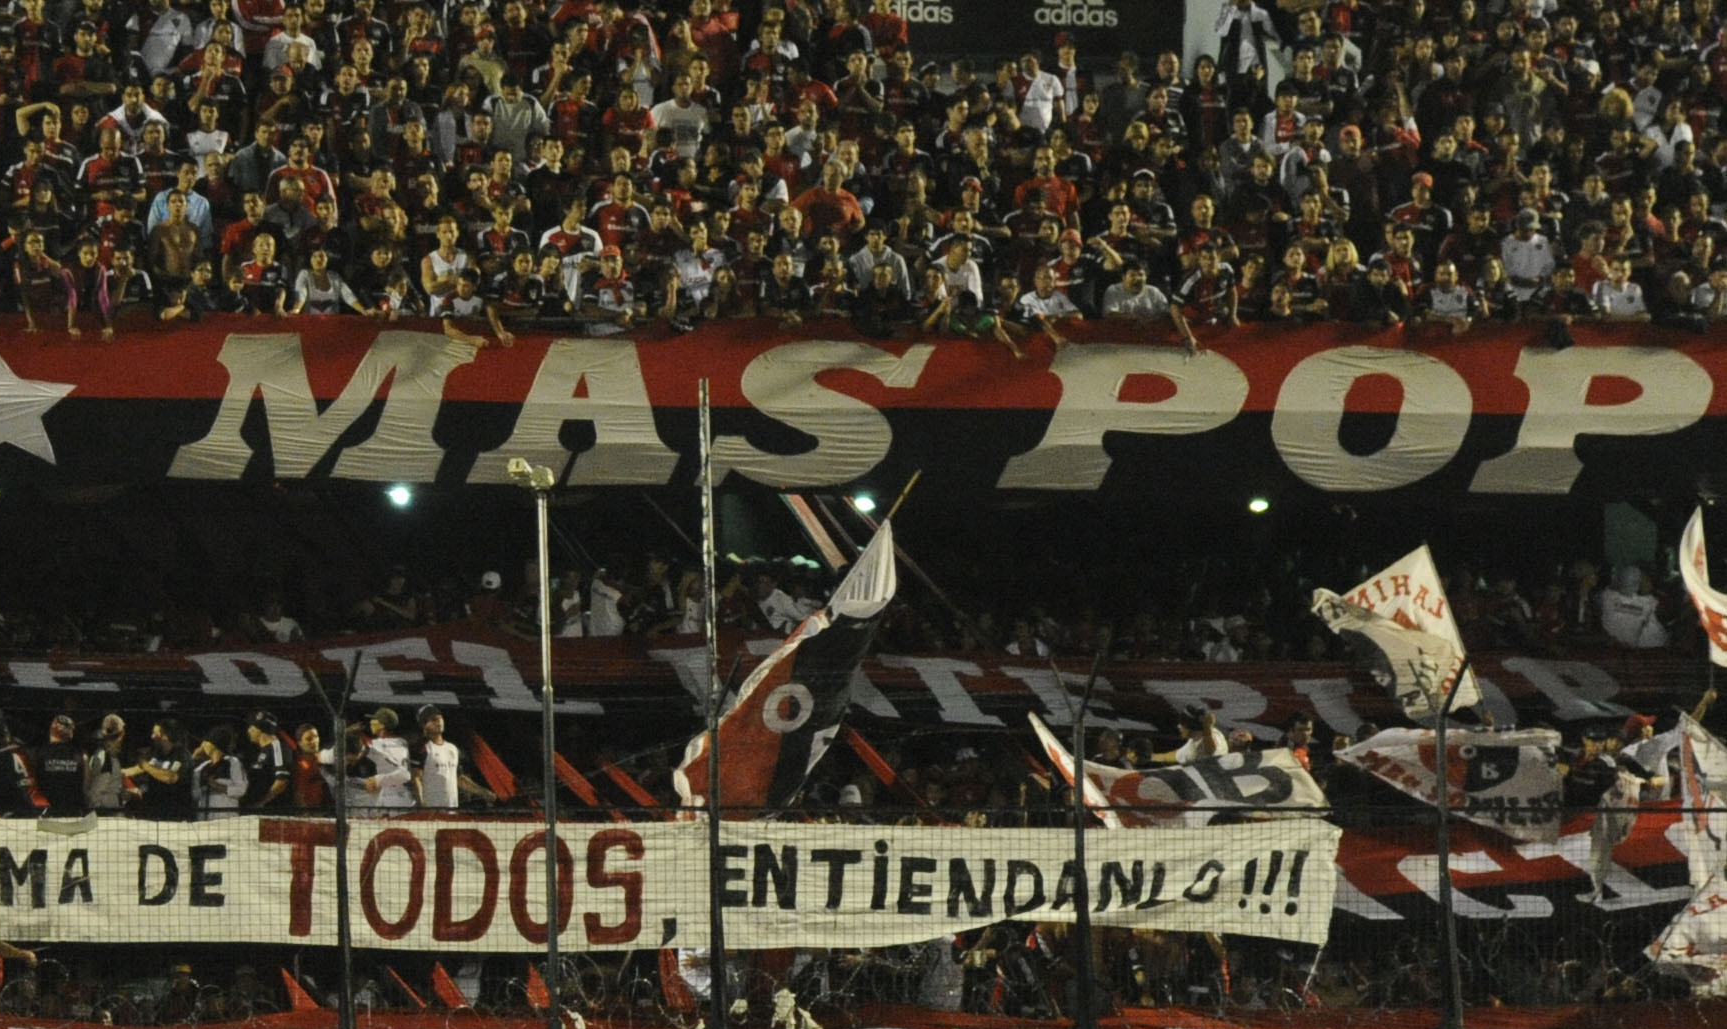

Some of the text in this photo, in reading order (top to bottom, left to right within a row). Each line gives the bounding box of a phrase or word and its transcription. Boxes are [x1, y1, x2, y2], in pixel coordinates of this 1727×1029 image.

[870, 1, 953, 24] didas
[1034, 2, 1118, 27] adidas
[166, 330, 935, 488] MAS
[995, 343, 1714, 494] POP
[181, 636, 606, 715] DEL
[138, 843, 227, 907] DE
